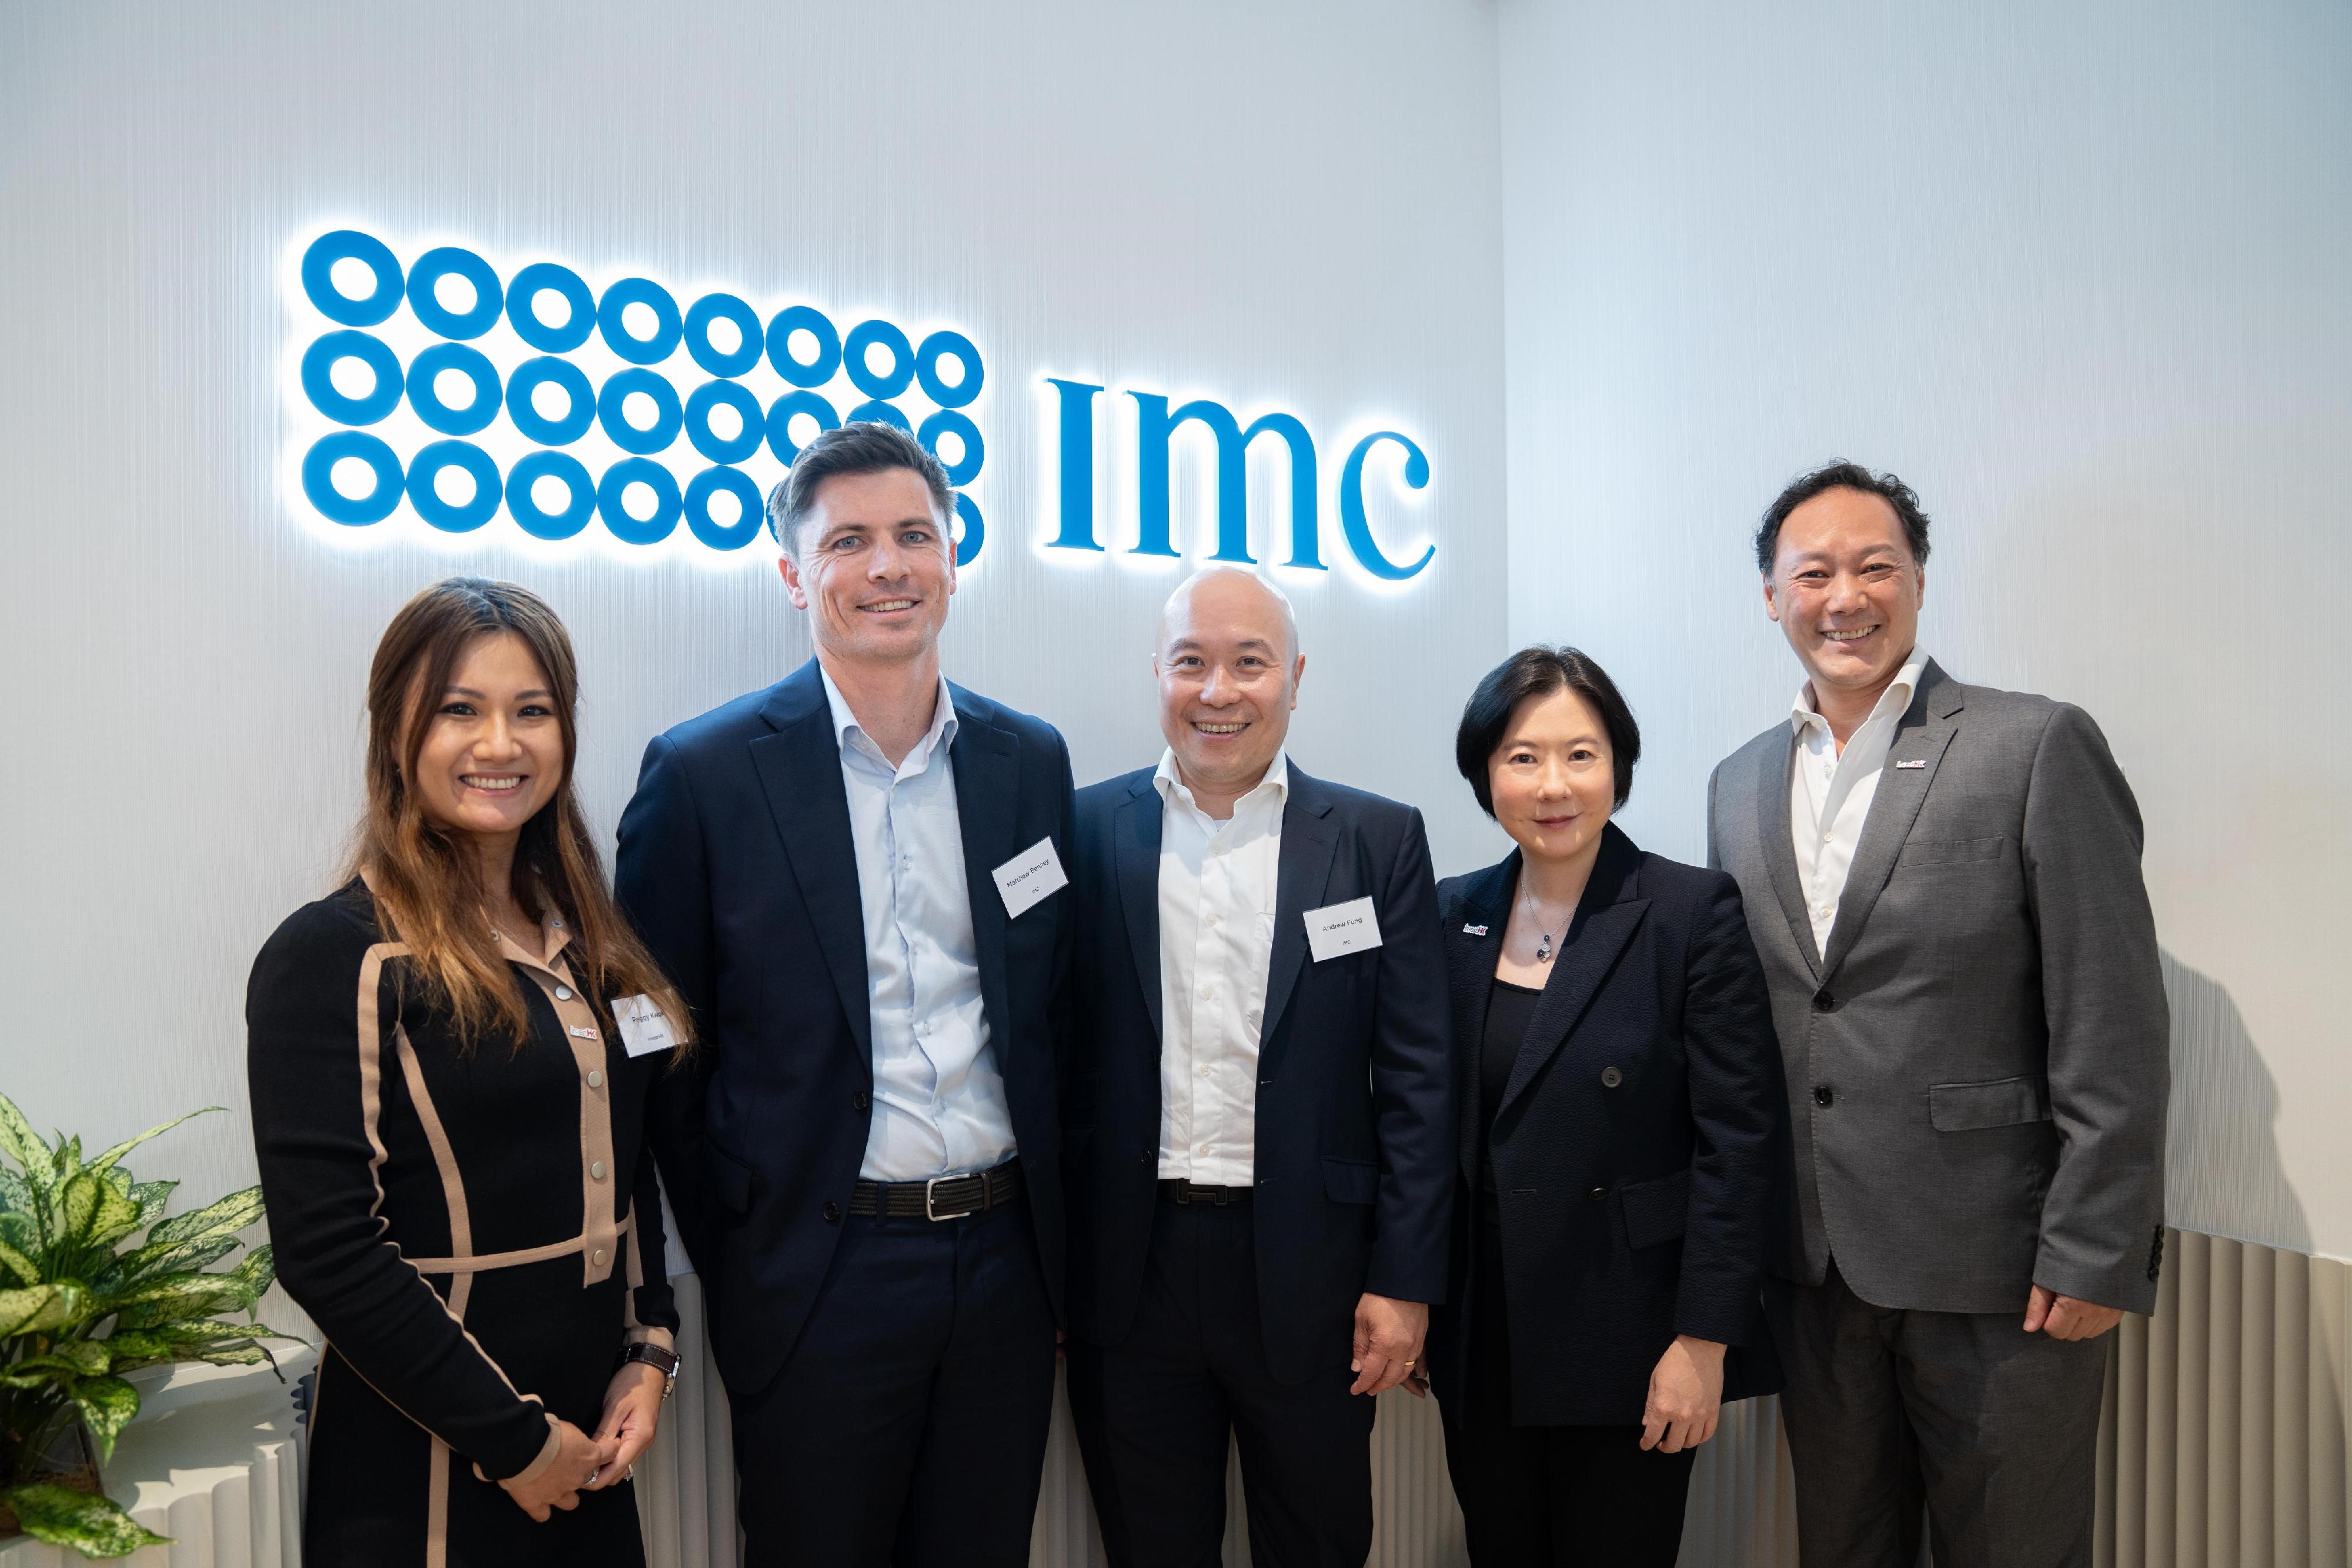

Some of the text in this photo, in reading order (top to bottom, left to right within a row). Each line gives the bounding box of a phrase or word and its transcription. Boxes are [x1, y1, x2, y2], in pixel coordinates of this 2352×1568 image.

[1007, 859, 1050, 888] Matthew Benney
[1323, 921, 1346, 932] Andrew
